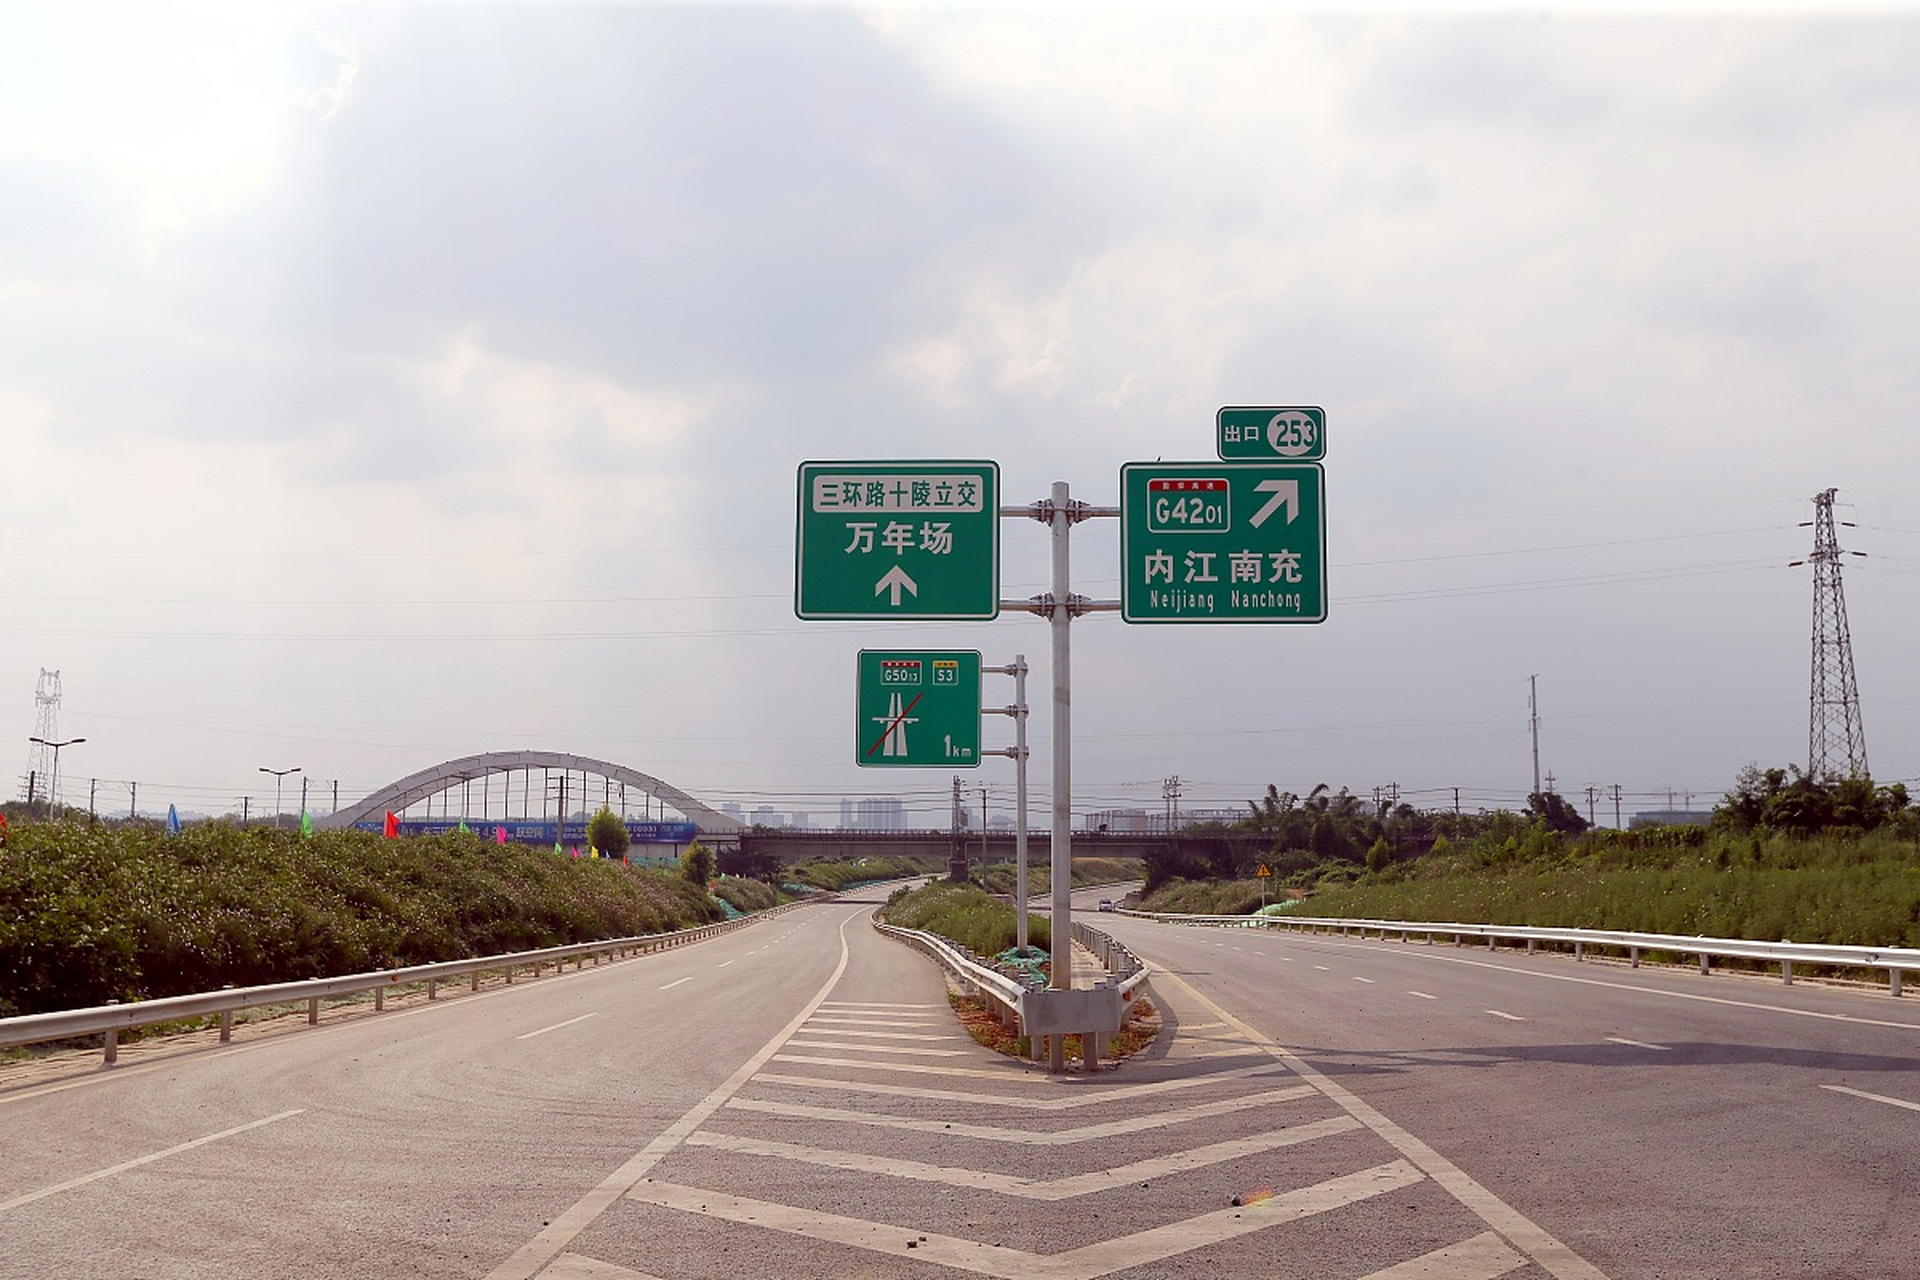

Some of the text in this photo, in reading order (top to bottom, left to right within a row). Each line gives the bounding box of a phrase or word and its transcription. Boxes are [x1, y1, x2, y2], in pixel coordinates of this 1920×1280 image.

[1224, 420, 1316, 447] 出口 253
[820, 480, 977, 508] 三环路十陵立交
[1155, 497, 1223, 525] G4201
[844, 521, 954, 556] 万年场
[1150, 589, 1301, 613] Neijiang Nanchong
[937, 669, 954, 682] S3
